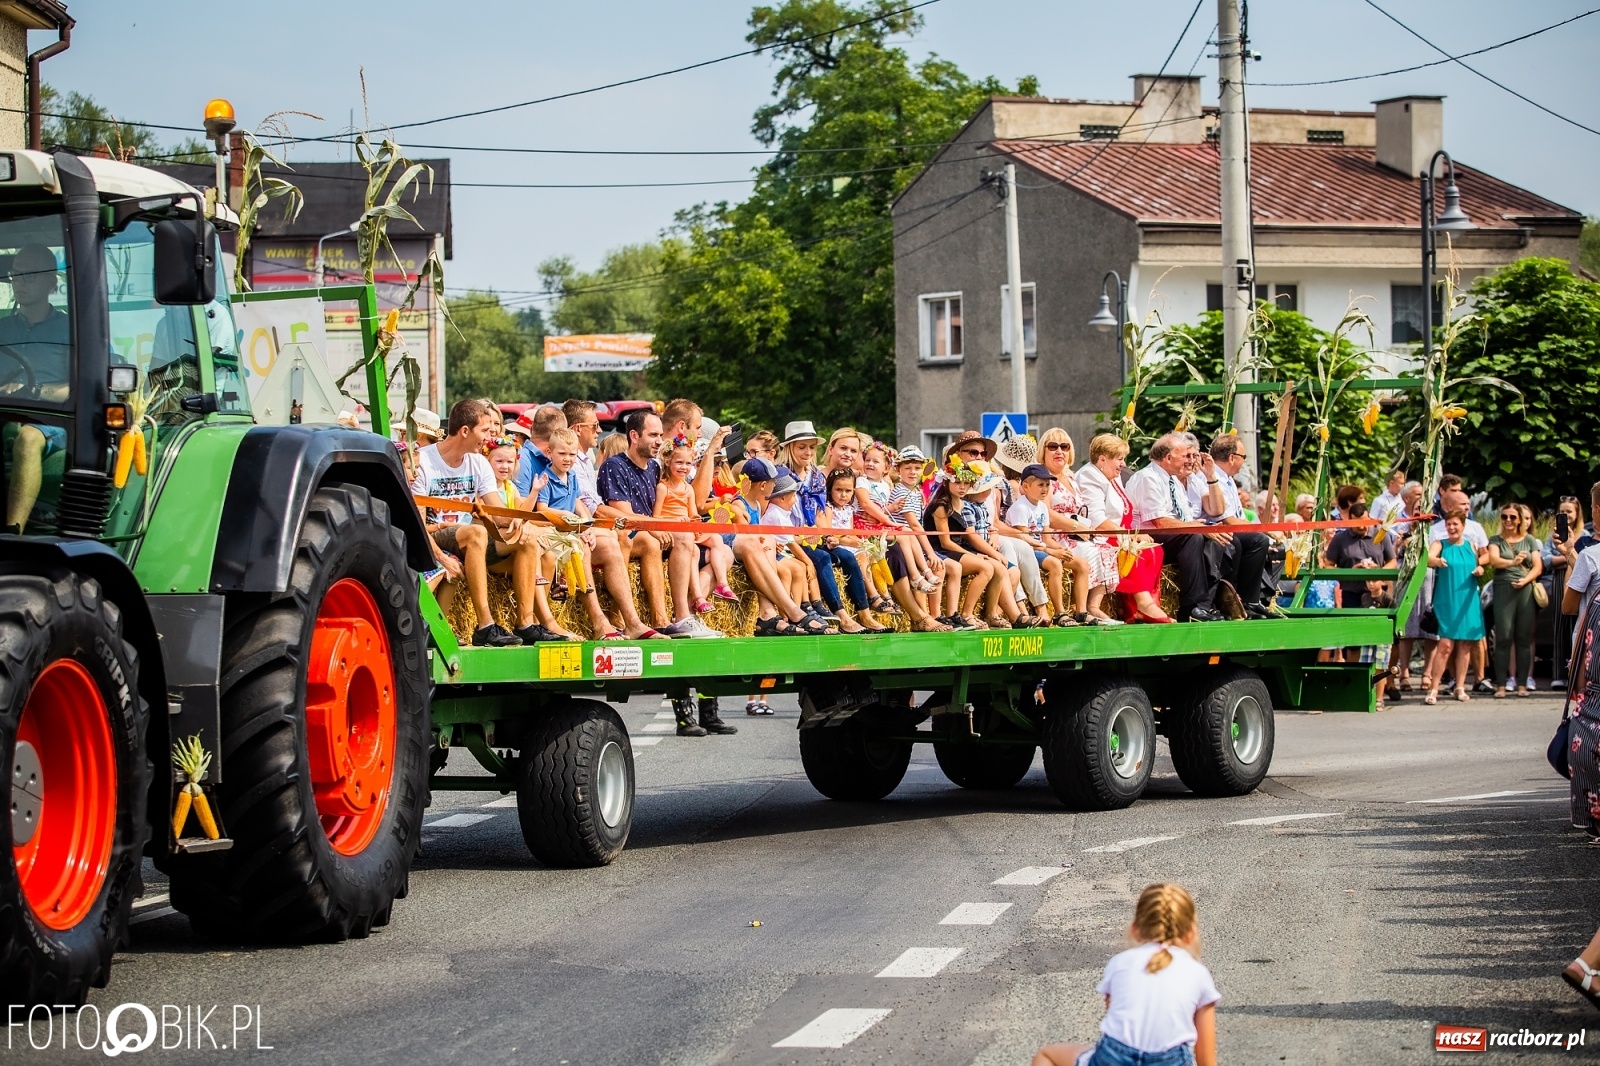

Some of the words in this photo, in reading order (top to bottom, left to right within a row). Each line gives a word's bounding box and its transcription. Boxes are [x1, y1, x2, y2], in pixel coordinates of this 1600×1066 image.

[265, 248, 345, 259] WAWRZNEK
[1009, 636, 1043, 656] PRONAR
[595, 655, 613, 673] 24
[95, 636, 139, 751] GRIPKER
[379, 562, 425, 847] GOODYEAR
